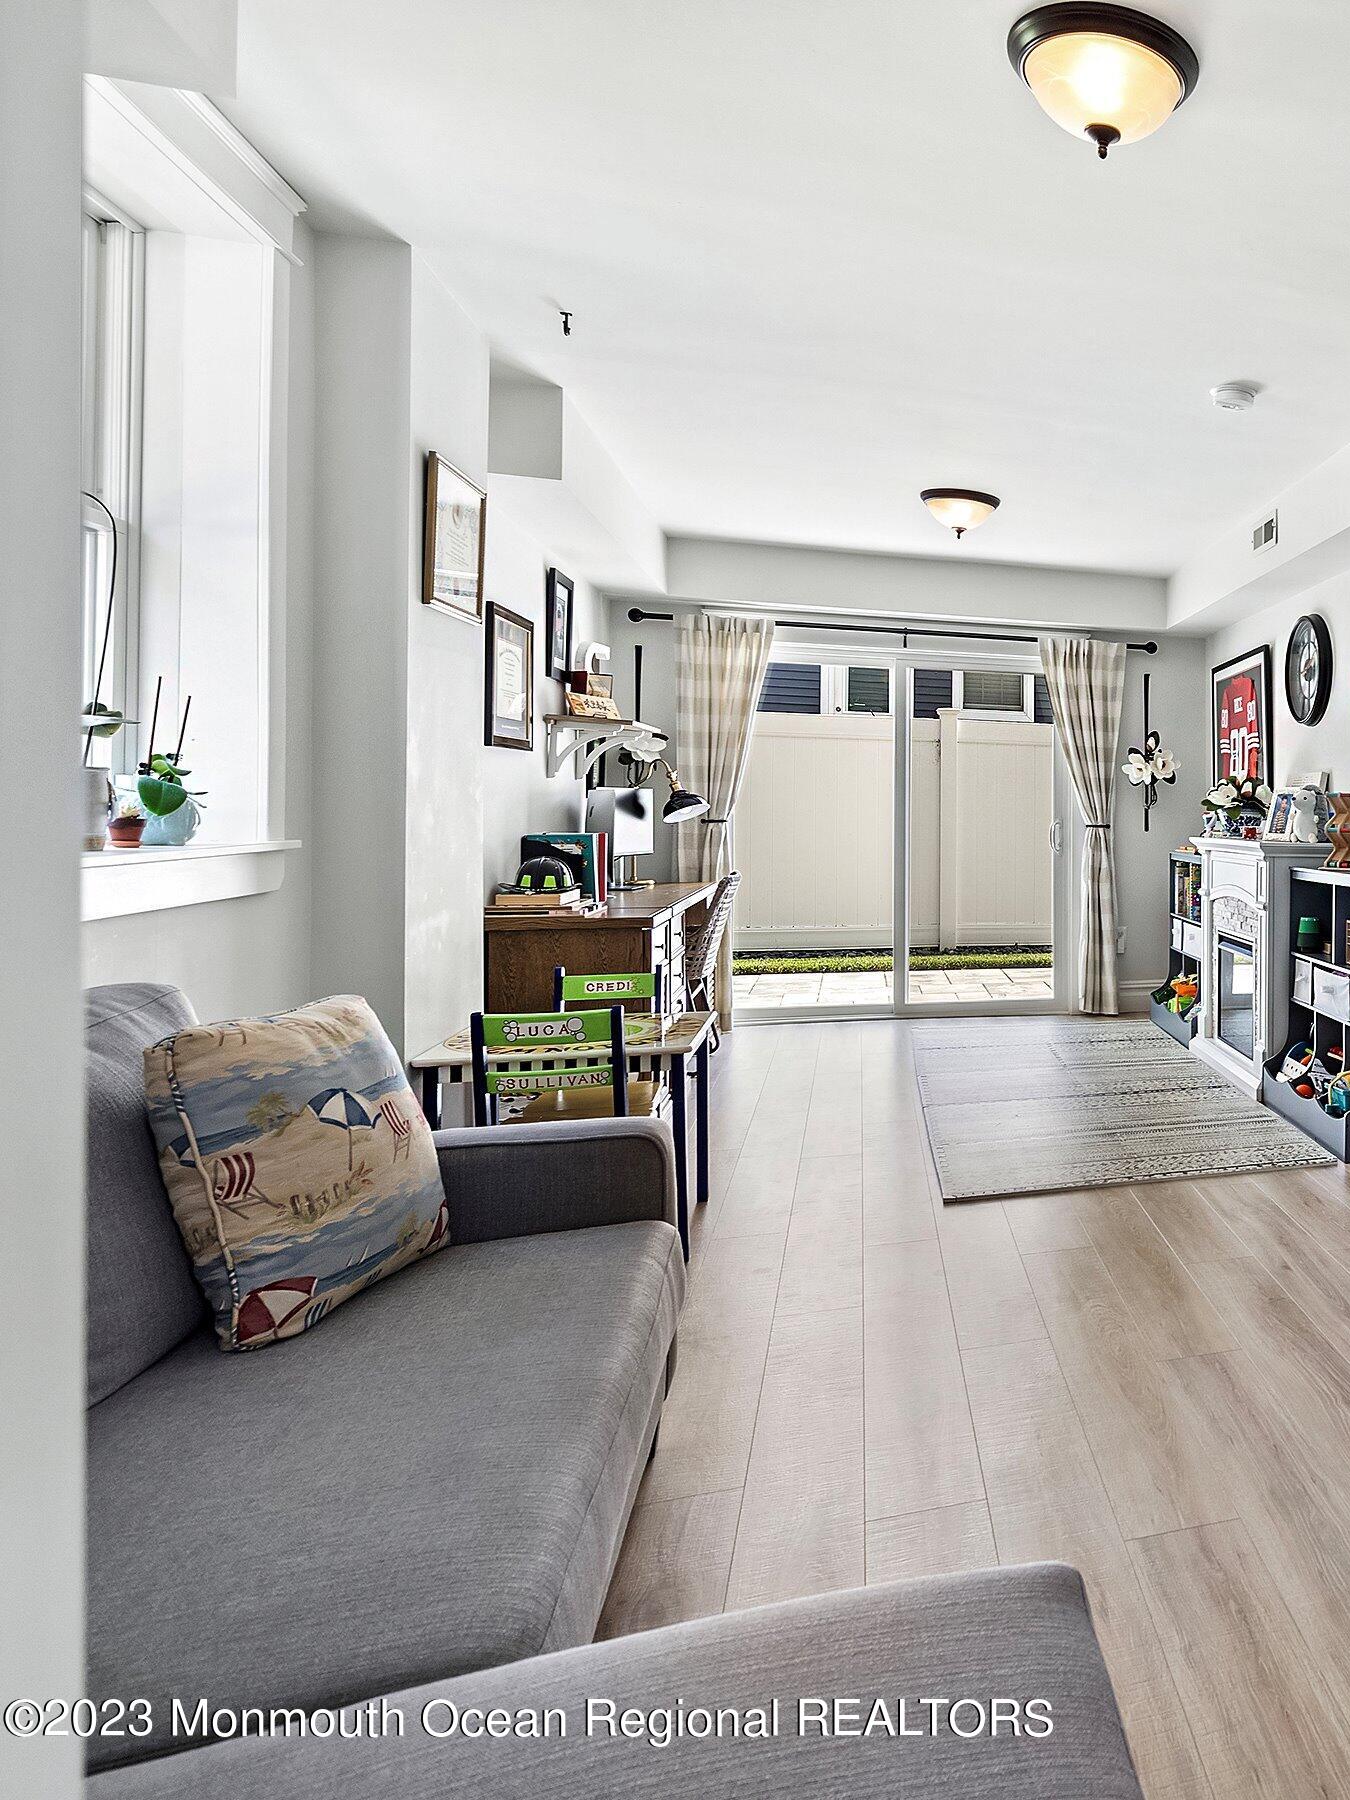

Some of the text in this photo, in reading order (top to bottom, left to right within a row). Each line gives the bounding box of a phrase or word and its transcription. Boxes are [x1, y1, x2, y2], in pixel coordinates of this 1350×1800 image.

[1230, 726, 1248, 782] 80
[586, 981, 631, 992] CREDI
[516, 1024, 570, 1037] LUCA
[506, 1072, 600, 1089] SULLIVAN
